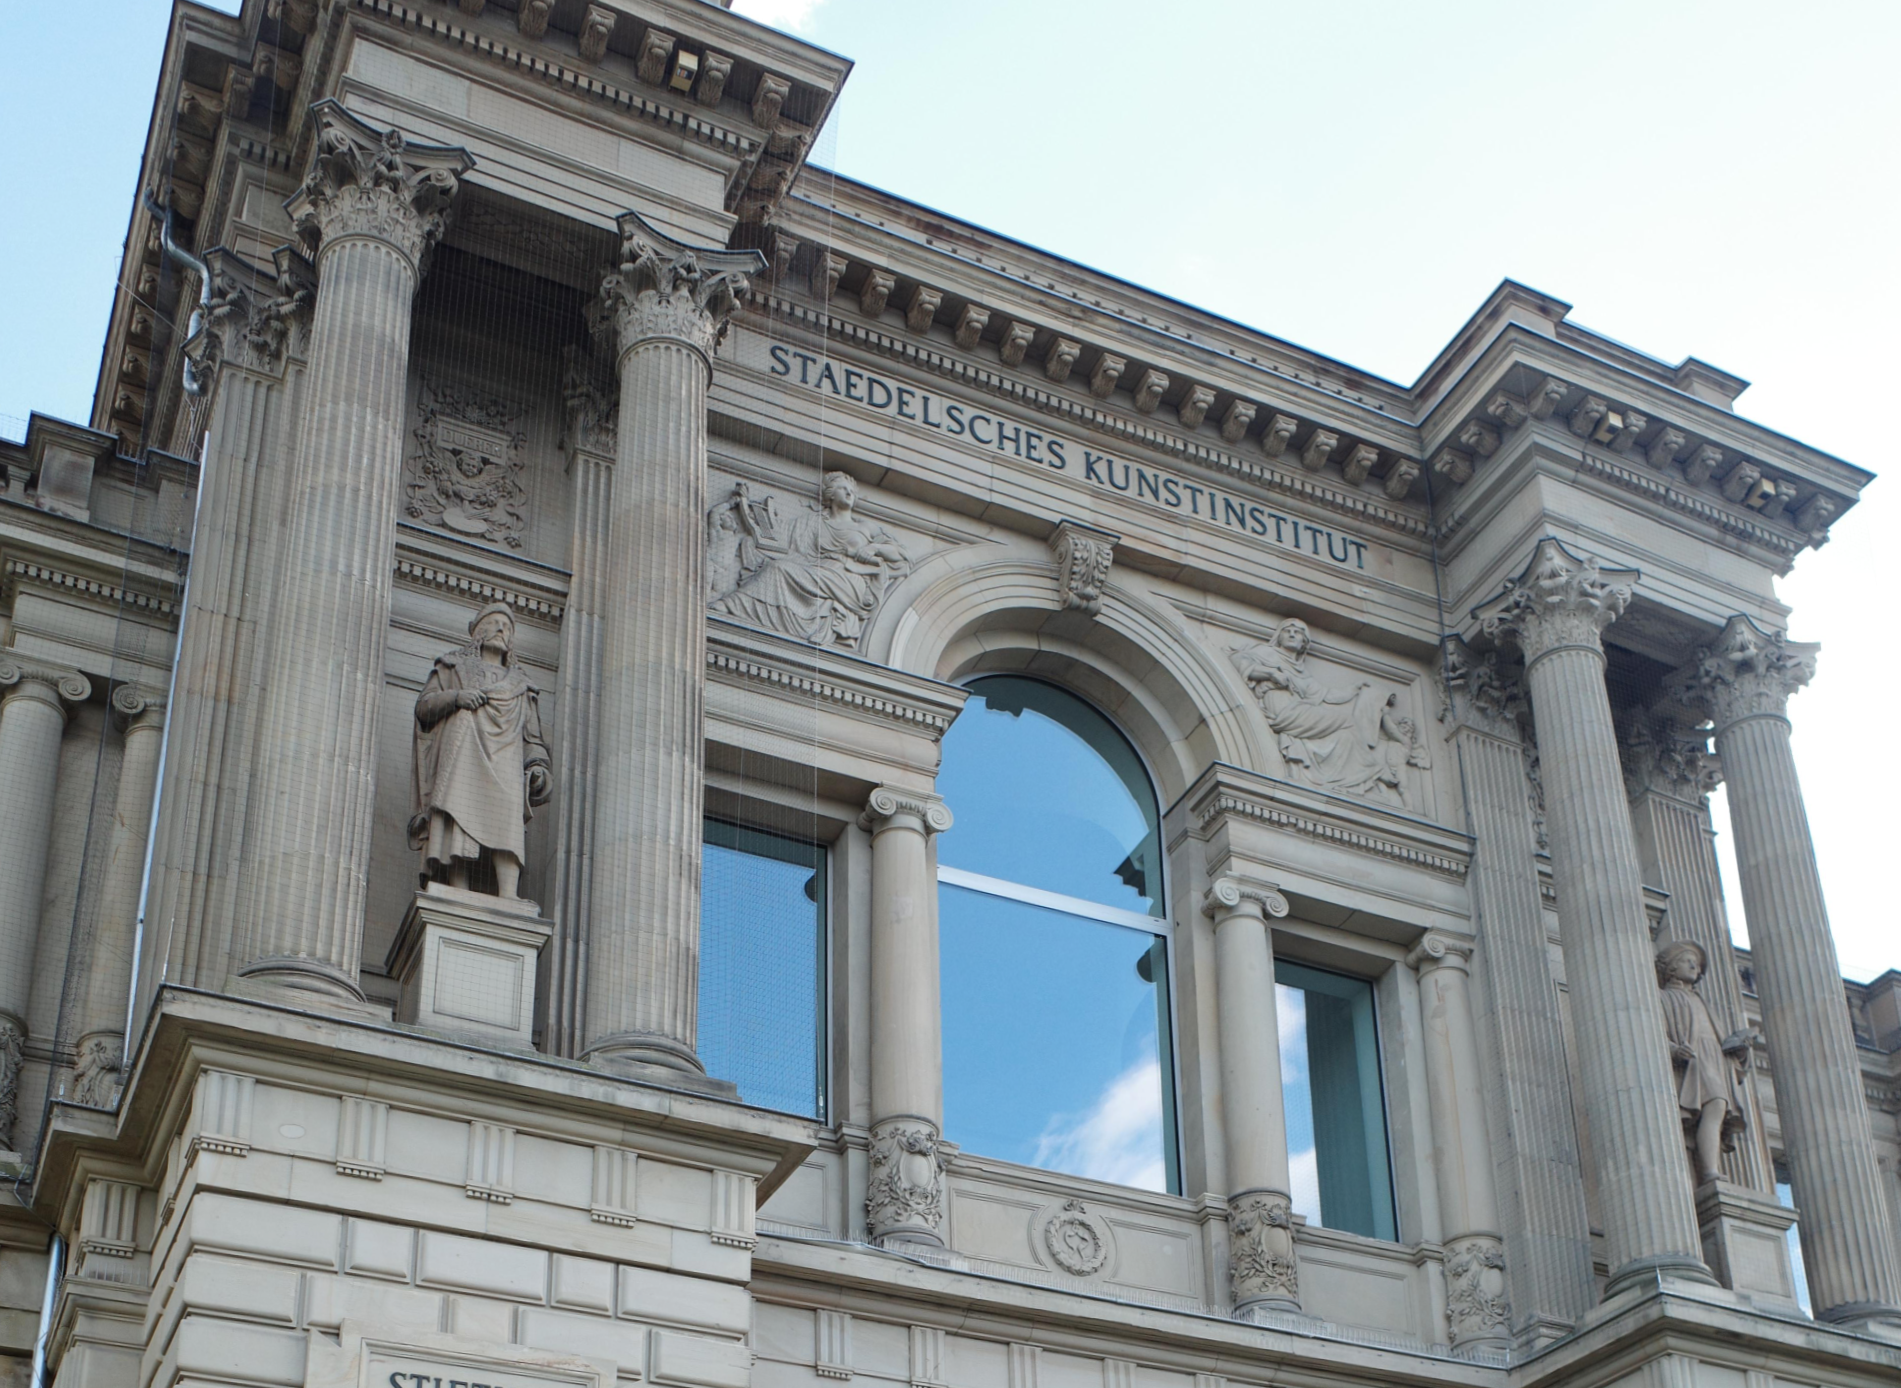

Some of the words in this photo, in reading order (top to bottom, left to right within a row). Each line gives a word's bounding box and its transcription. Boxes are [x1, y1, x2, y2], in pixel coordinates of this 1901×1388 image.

[443, 428, 503, 458] DUERER
[769, 344, 1067, 470] STAEDELSCHES
[1084, 451, 1369, 569] KUNSTINSTITUT
